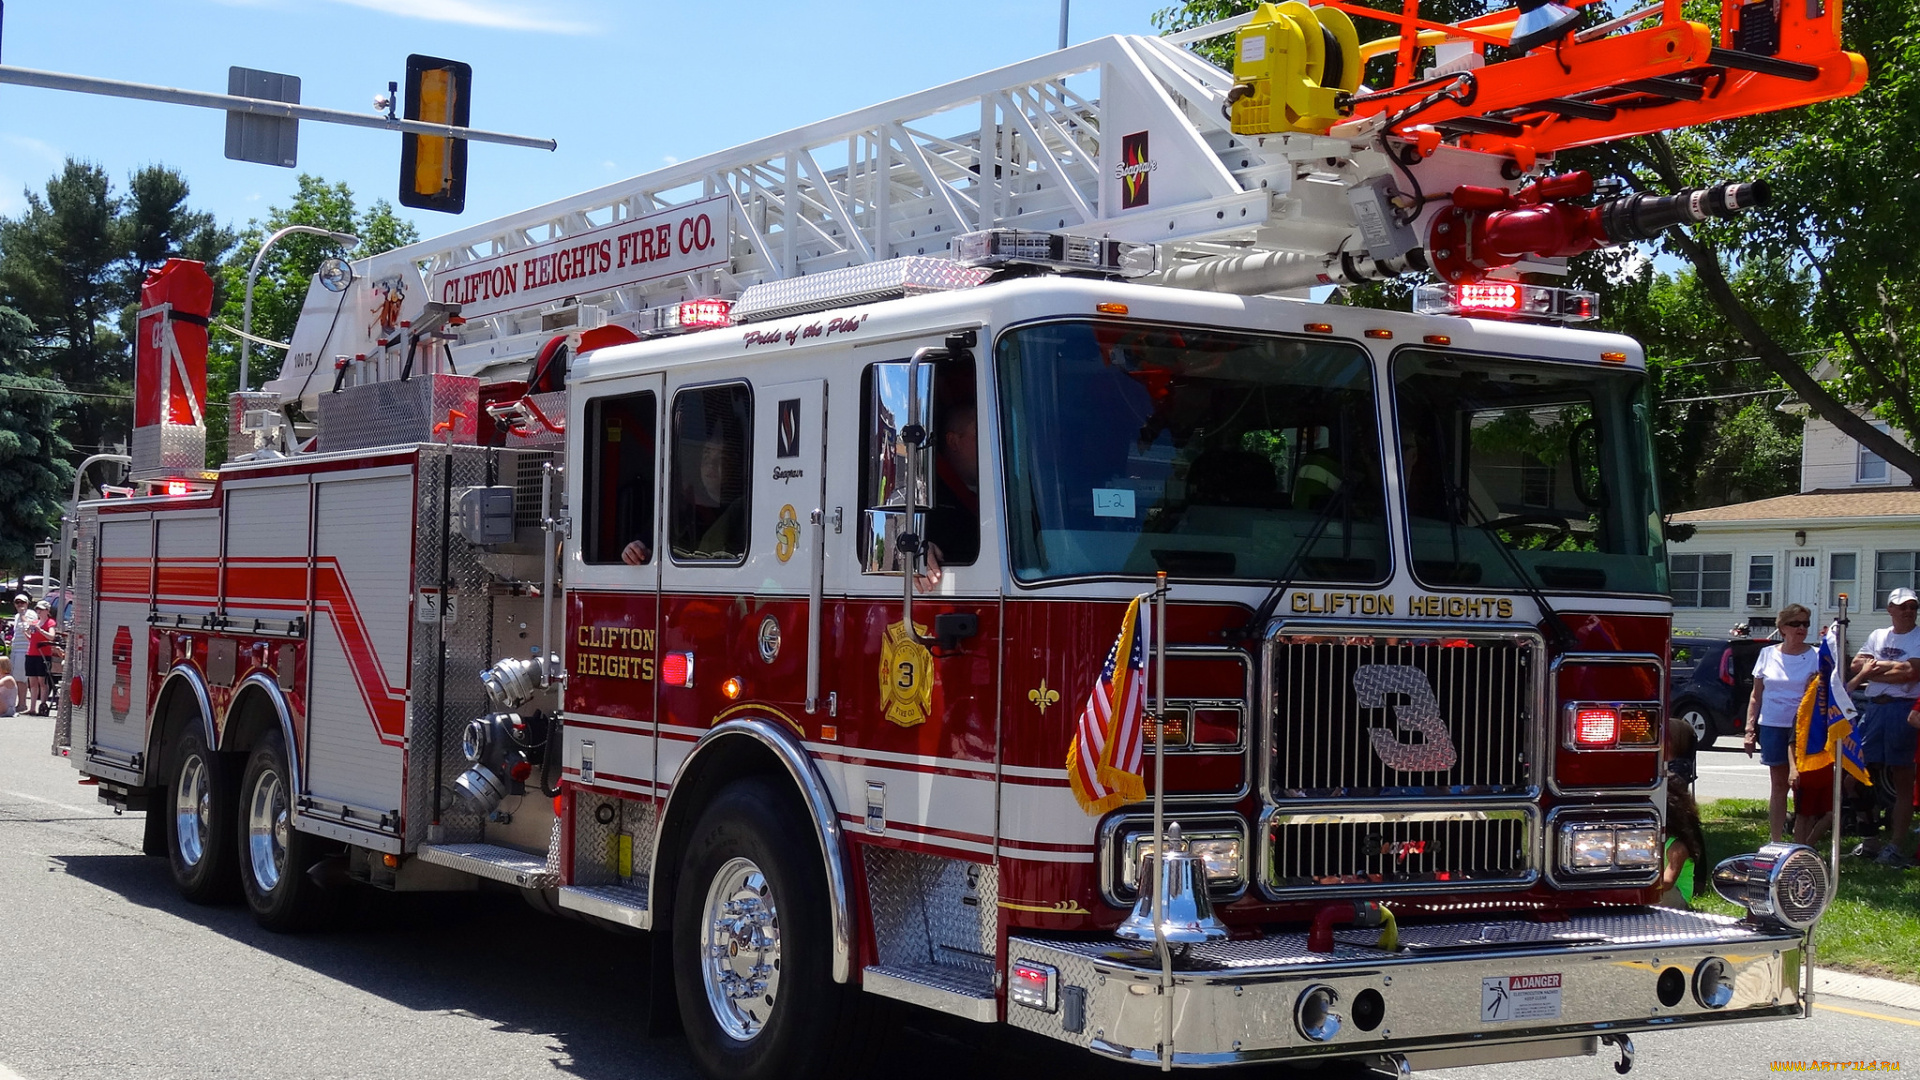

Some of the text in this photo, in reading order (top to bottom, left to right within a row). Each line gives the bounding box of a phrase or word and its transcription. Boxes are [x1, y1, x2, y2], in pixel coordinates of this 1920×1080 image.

[443, 213, 715, 304] CLIFTON HEIGHTS FIRE CO.
[785, 324, 801, 346] of
[803, 321, 823, 339] the
[294, 353, 304, 368] 100
[1291, 592, 1513, 617] CLIFTON HEIGHTS
[577, 625, 655, 651] CLIFTON
[577, 653, 654, 680] HEIGHTS
[898, 662, 914, 688] 3
[1352, 664, 1458, 772] 3
[1522, 975, 1559, 988] DANGER
